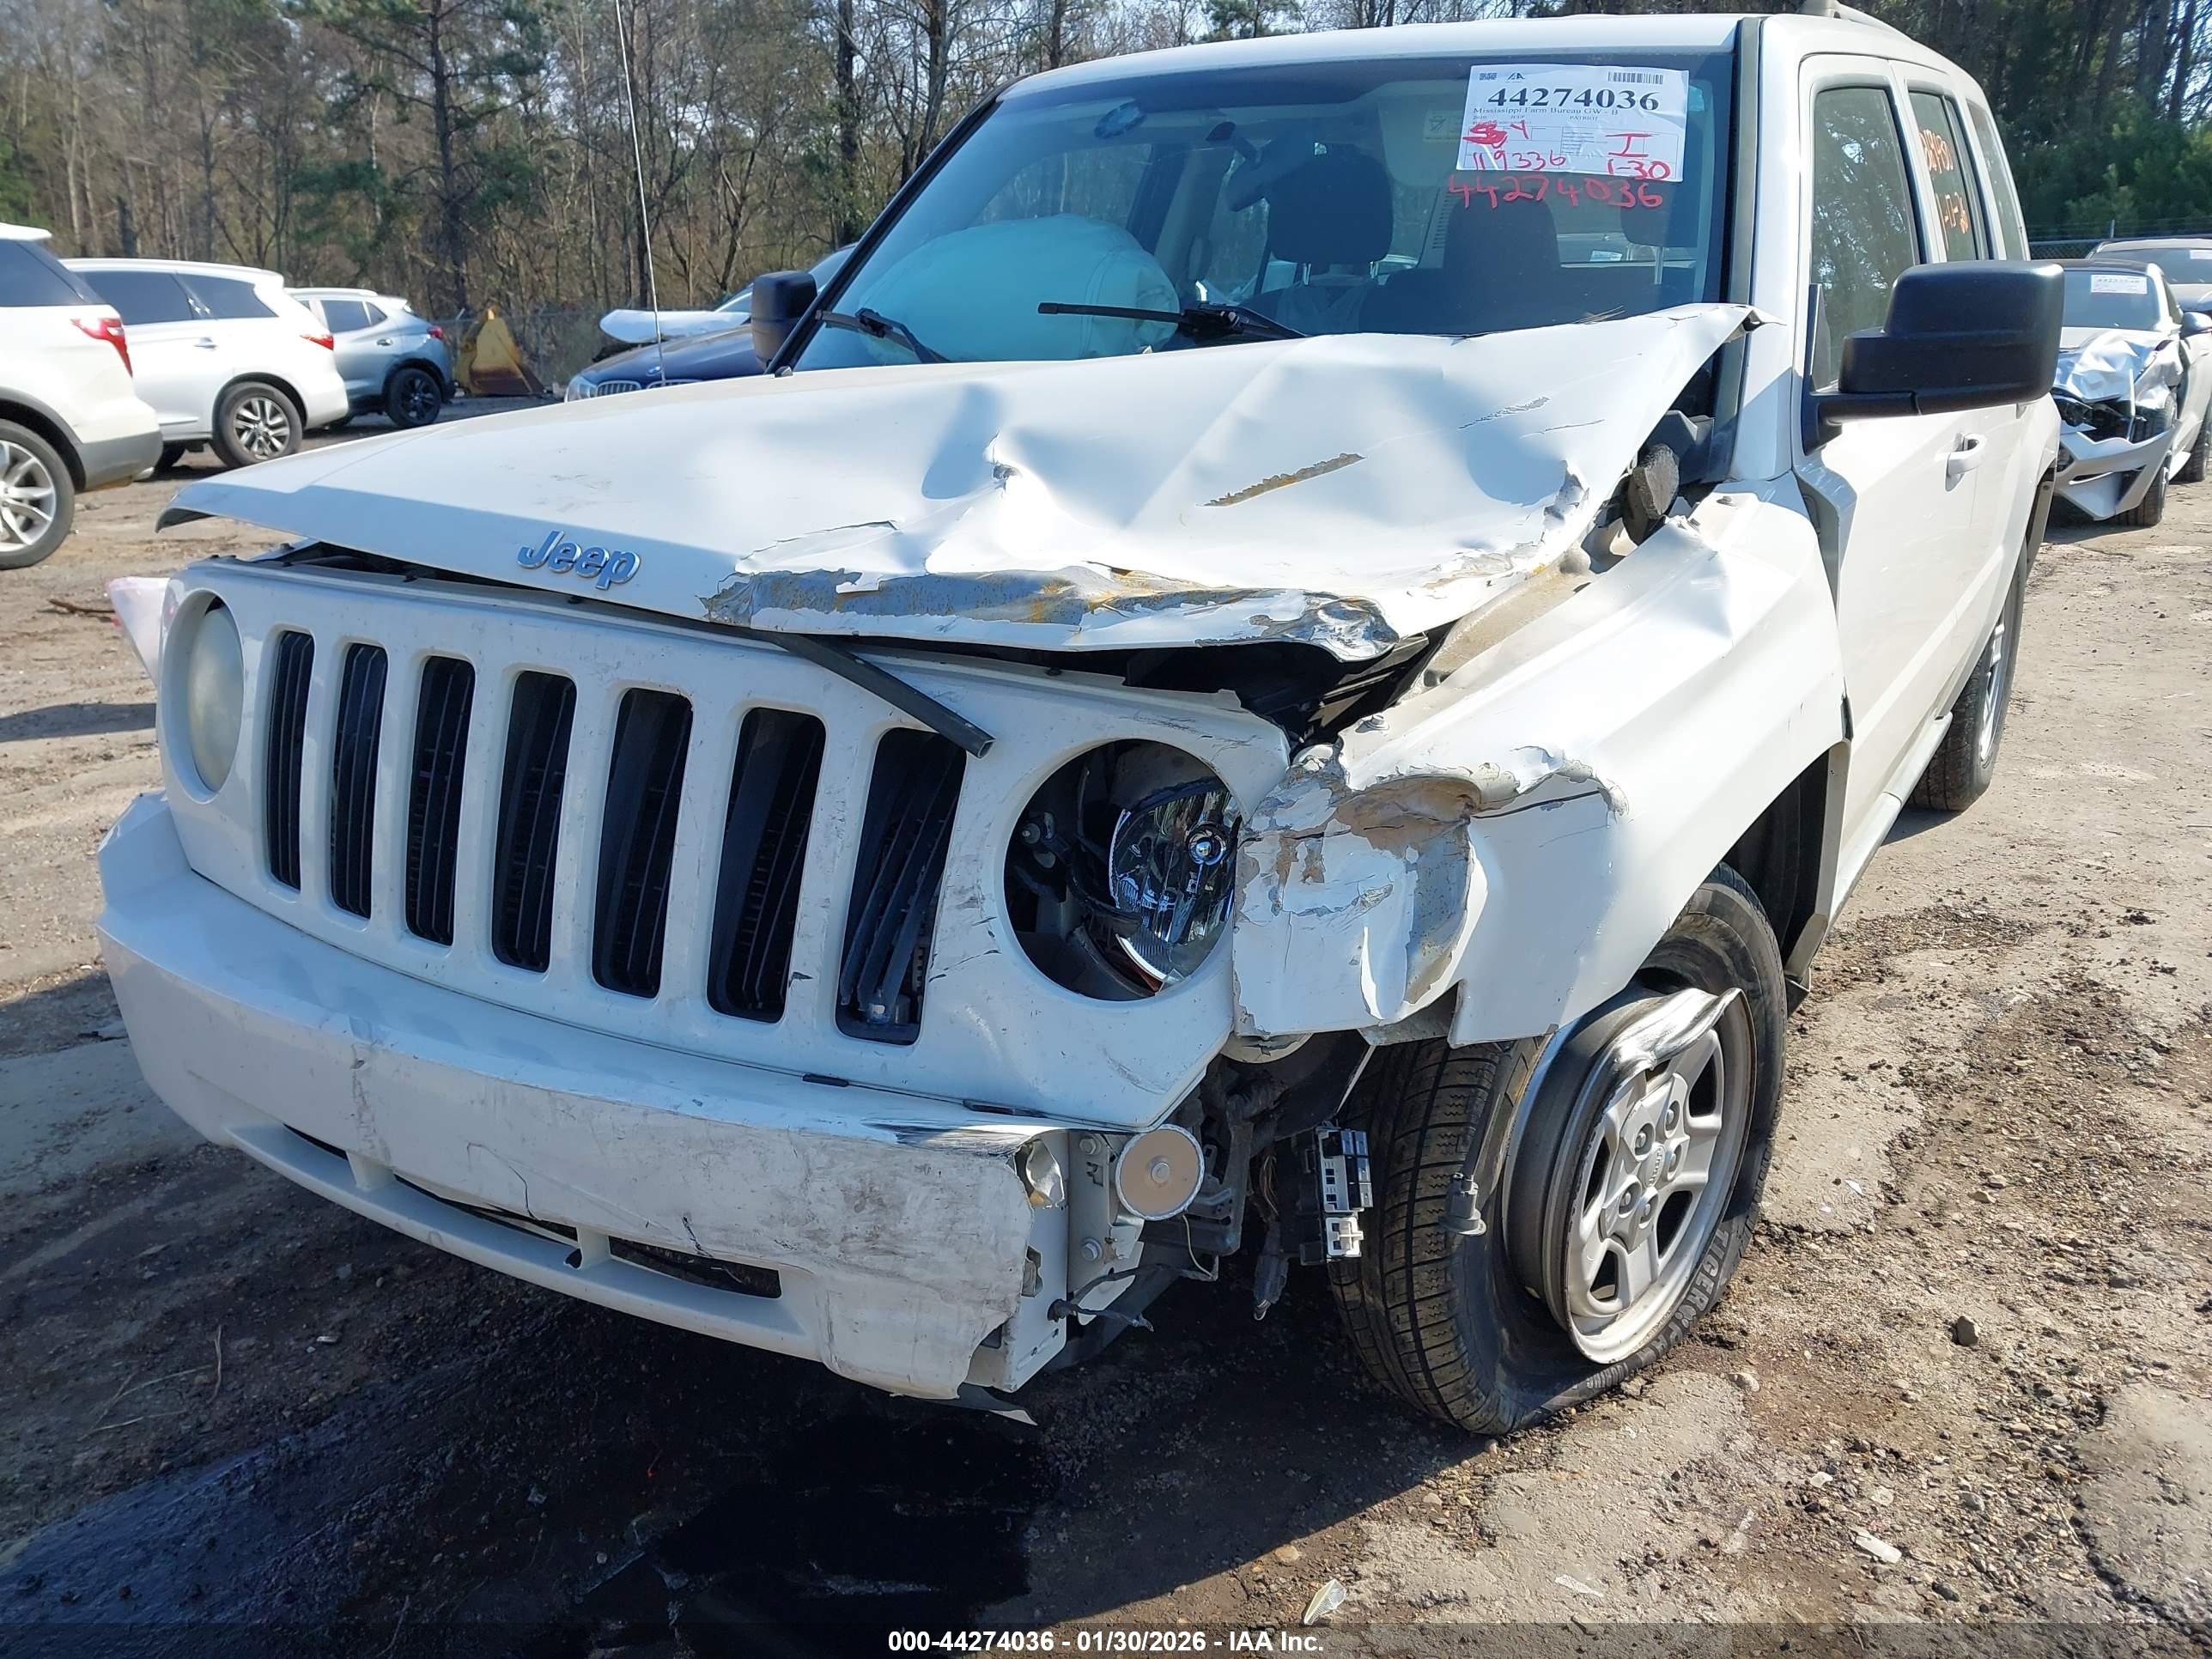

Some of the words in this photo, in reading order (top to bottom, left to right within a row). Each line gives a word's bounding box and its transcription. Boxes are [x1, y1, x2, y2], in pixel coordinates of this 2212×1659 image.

[1487, 88, 1660, 111] 44274036
[1447, 174, 1663, 209] 44274036
[517, 530, 641, 591] Jeep
[1686, 1228, 1729, 1312] TIGER
